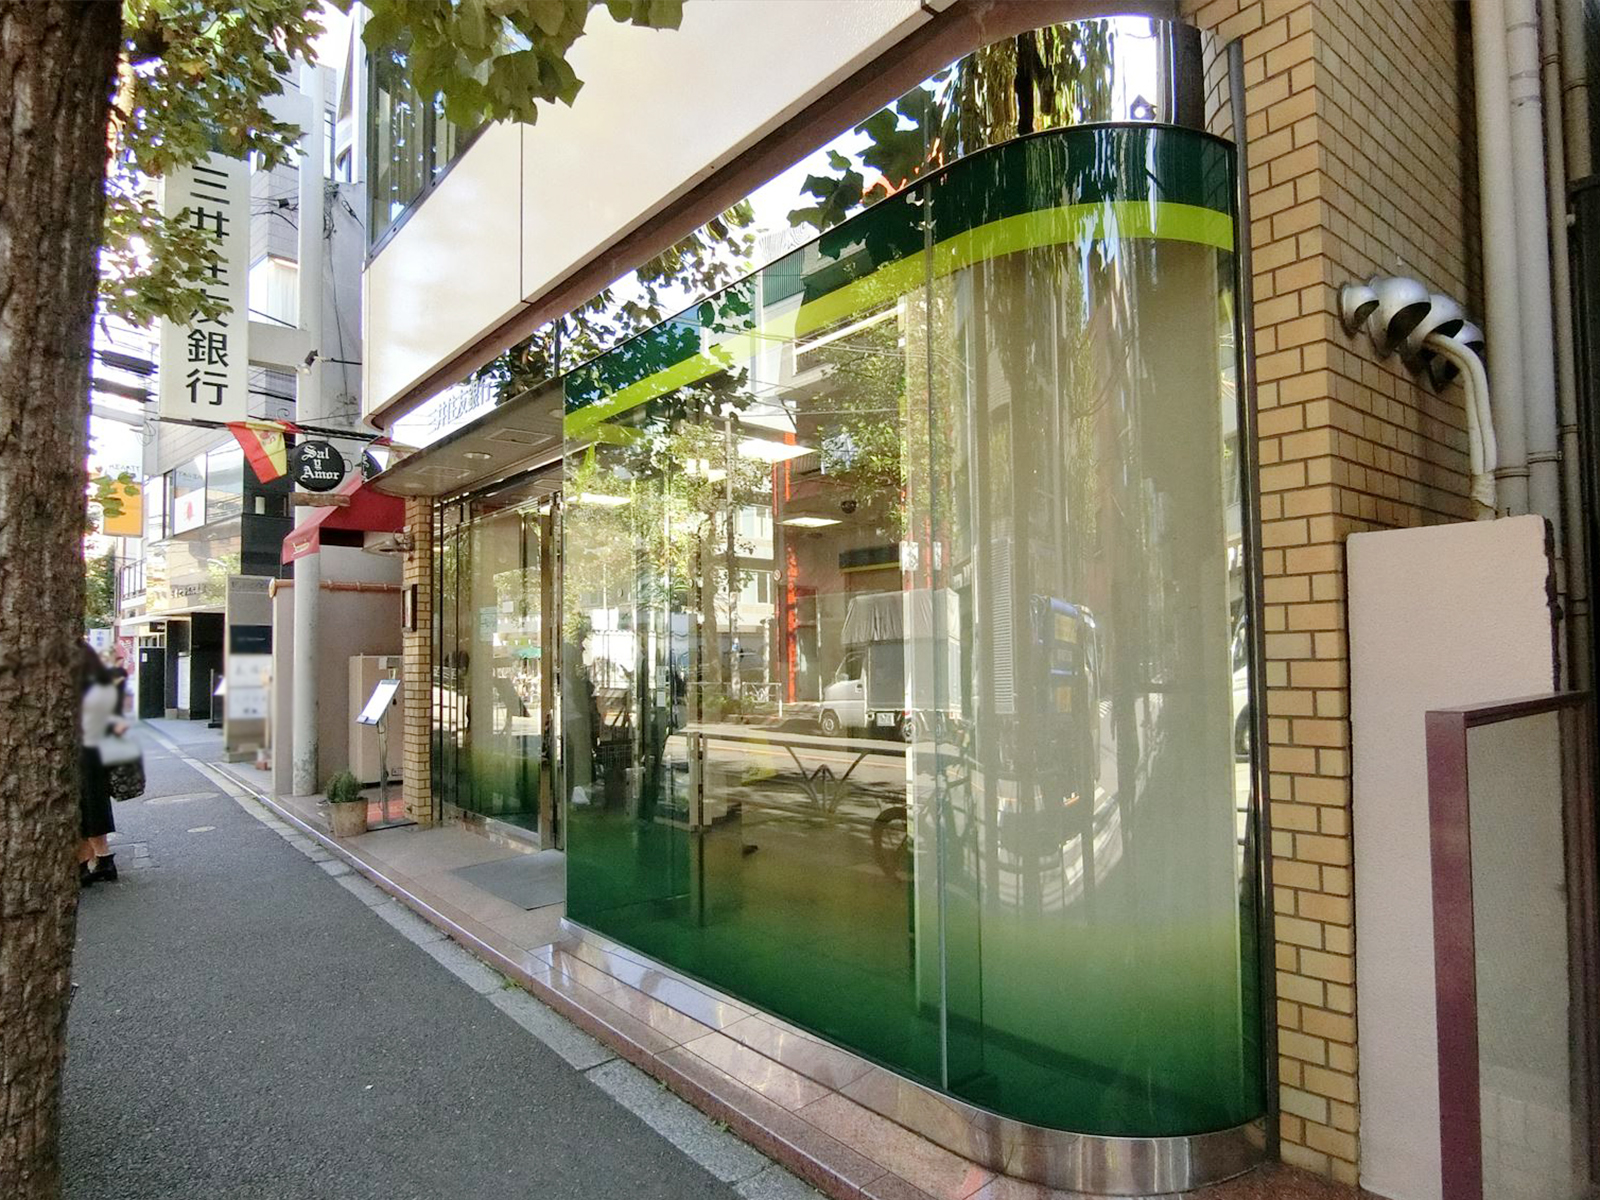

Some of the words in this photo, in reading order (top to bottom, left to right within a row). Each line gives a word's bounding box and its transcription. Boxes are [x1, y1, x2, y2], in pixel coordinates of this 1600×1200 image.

[301, 445, 330, 461] Sal
[313, 459, 322, 470] y
[300, 465, 340, 482] Amor
